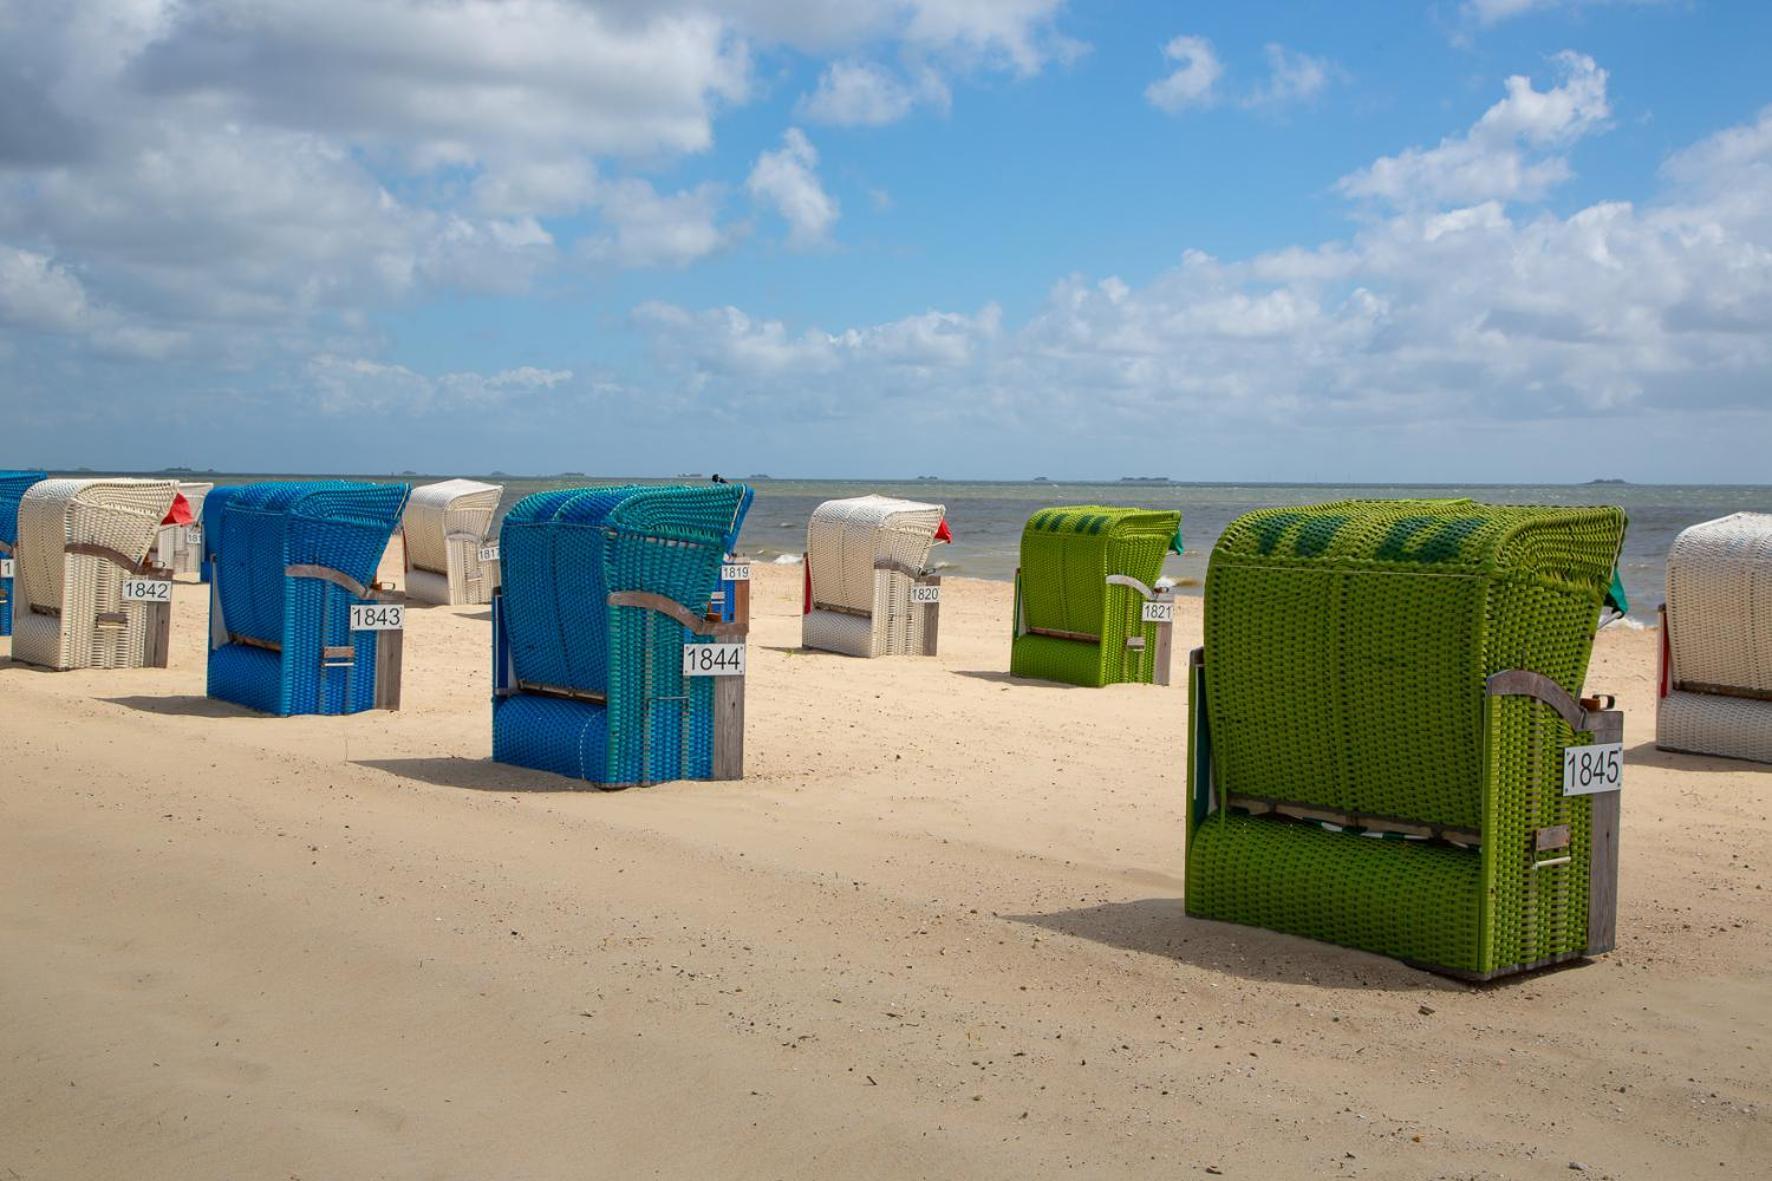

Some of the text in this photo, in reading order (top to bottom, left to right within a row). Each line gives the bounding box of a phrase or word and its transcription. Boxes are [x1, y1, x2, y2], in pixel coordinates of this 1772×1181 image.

[480, 548, 499, 560] 181
[723, 566, 749, 578] 1819
[125, 582, 169, 599] 1842
[912, 587, 939, 601] 1820
[353, 607, 401, 627] 1843
[1144, 604, 1172, 619] 1821
[688, 647, 740, 671] 1844
[1568, 750, 1619, 787] 1845
